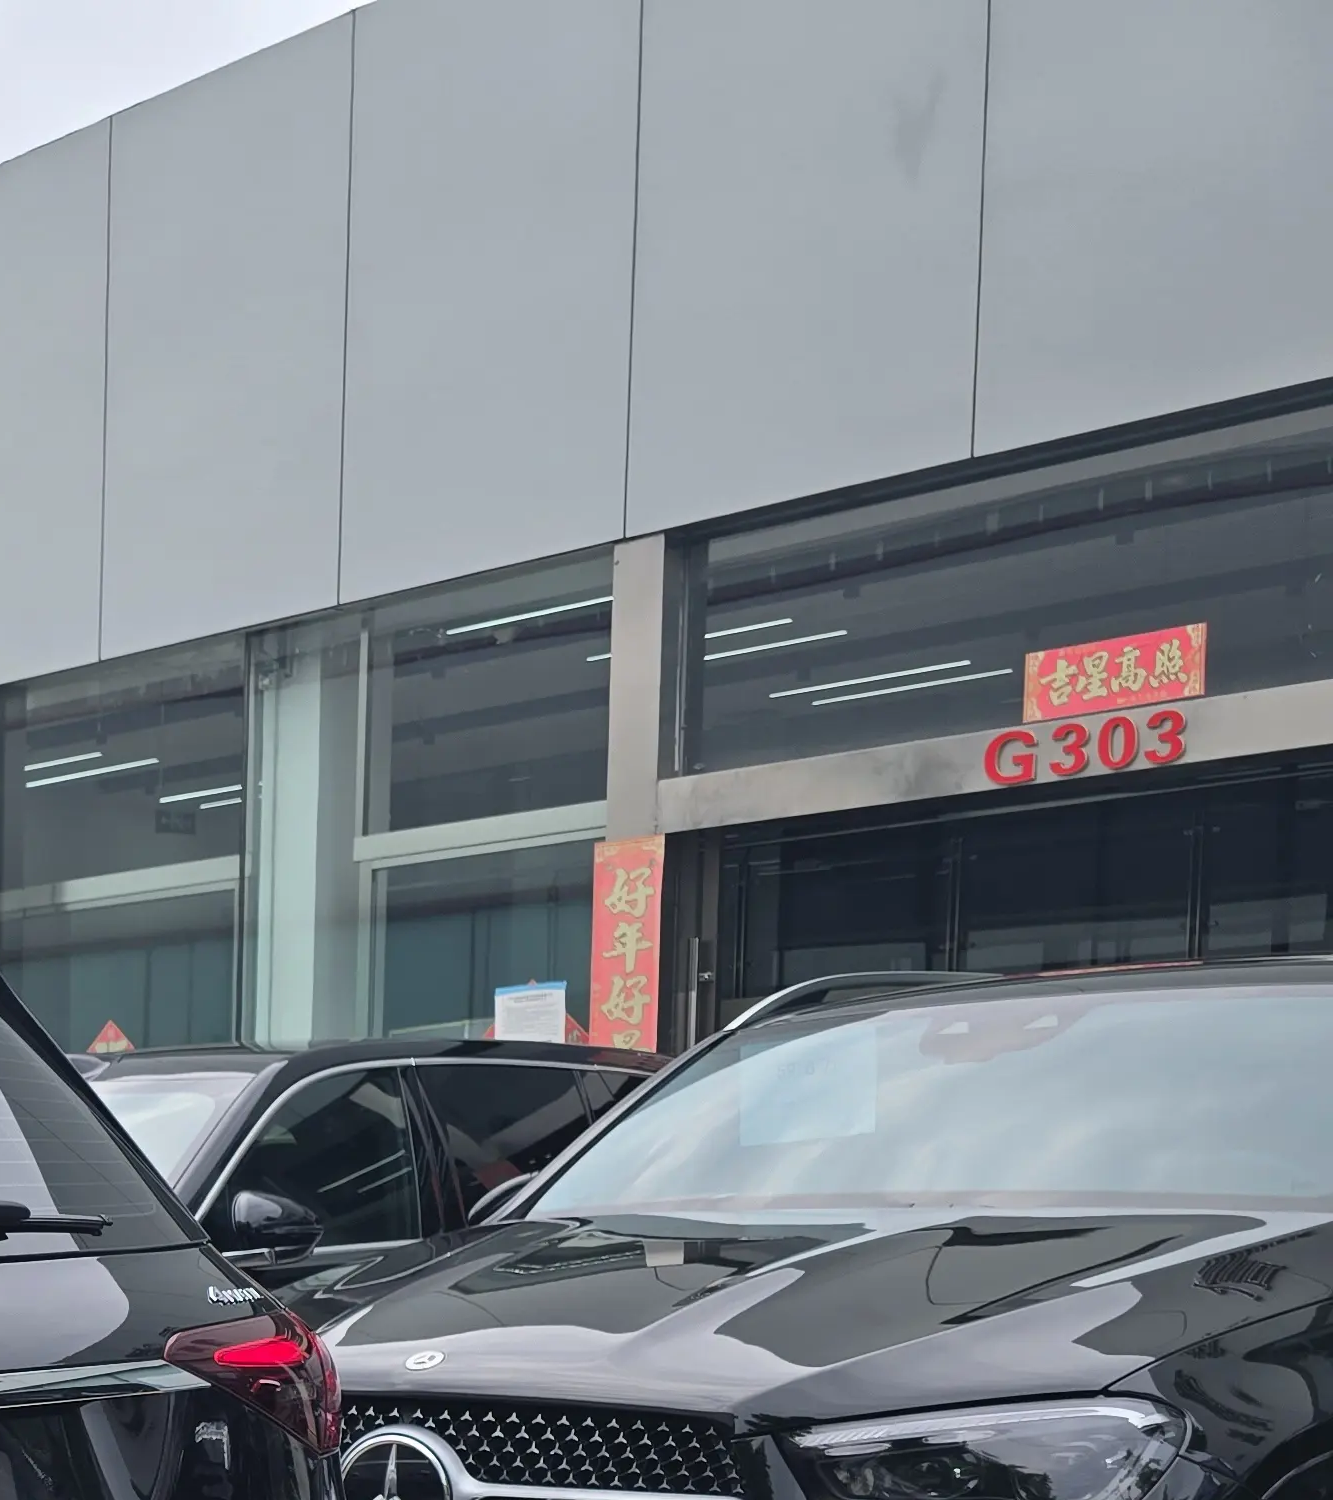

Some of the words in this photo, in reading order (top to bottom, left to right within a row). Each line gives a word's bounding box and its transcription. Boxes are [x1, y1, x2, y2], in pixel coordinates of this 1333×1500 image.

[1039, 639, 1188, 705] 吉星高照
[983, 710, 1187, 786] G303
